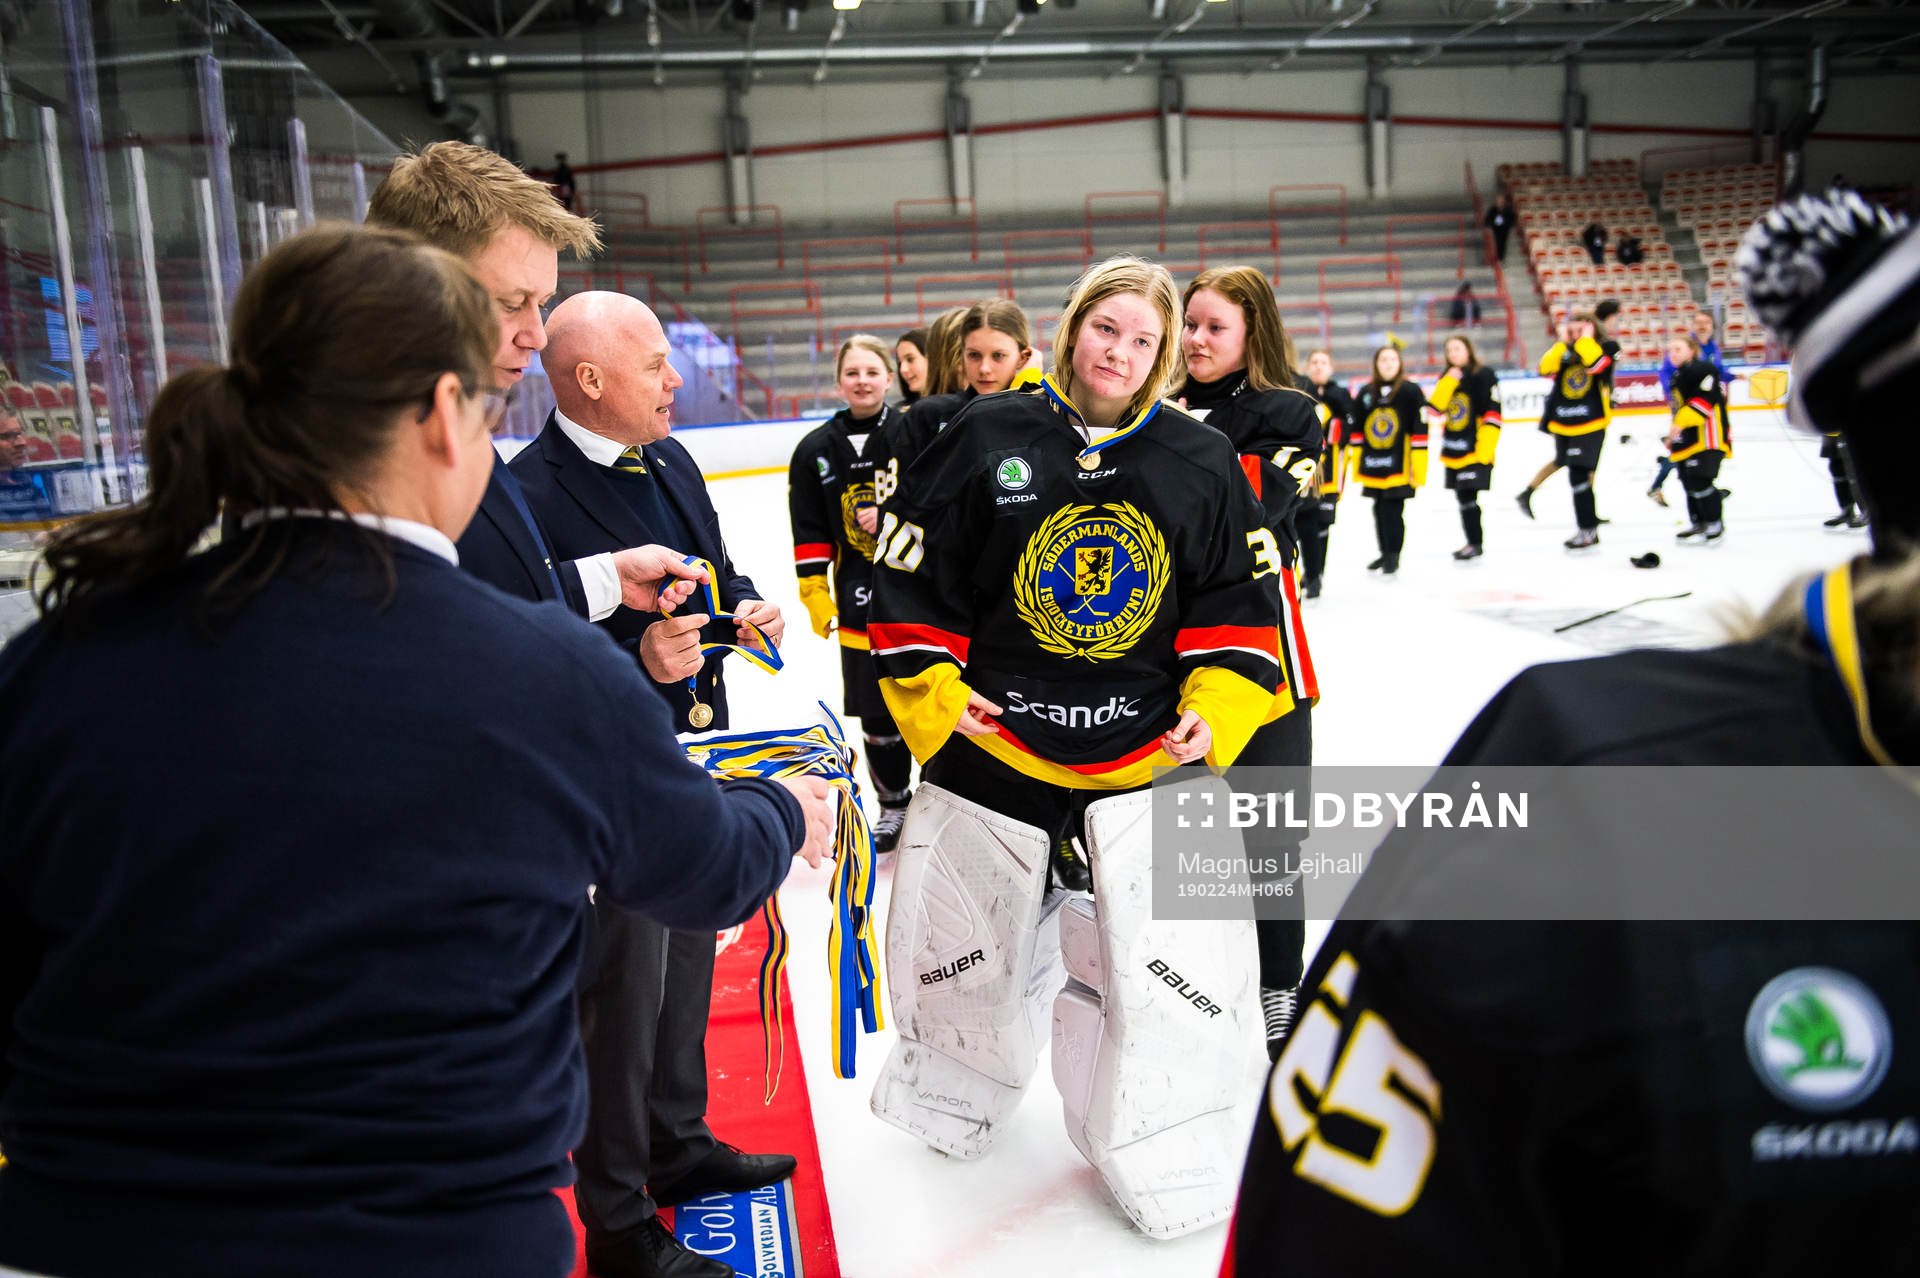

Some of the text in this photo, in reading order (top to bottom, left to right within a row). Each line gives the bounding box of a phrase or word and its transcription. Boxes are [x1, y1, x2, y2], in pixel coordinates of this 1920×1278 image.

[1077, 467, 1117, 480] CCM
[996, 493, 1038, 505] ŠKODA
[1042, 523, 1147, 573] SÖDERMANLANDS
[1039, 586, 1145, 638] ISHOCKEYFÖRBUND
[1006, 691, 1141, 729] Scandic
